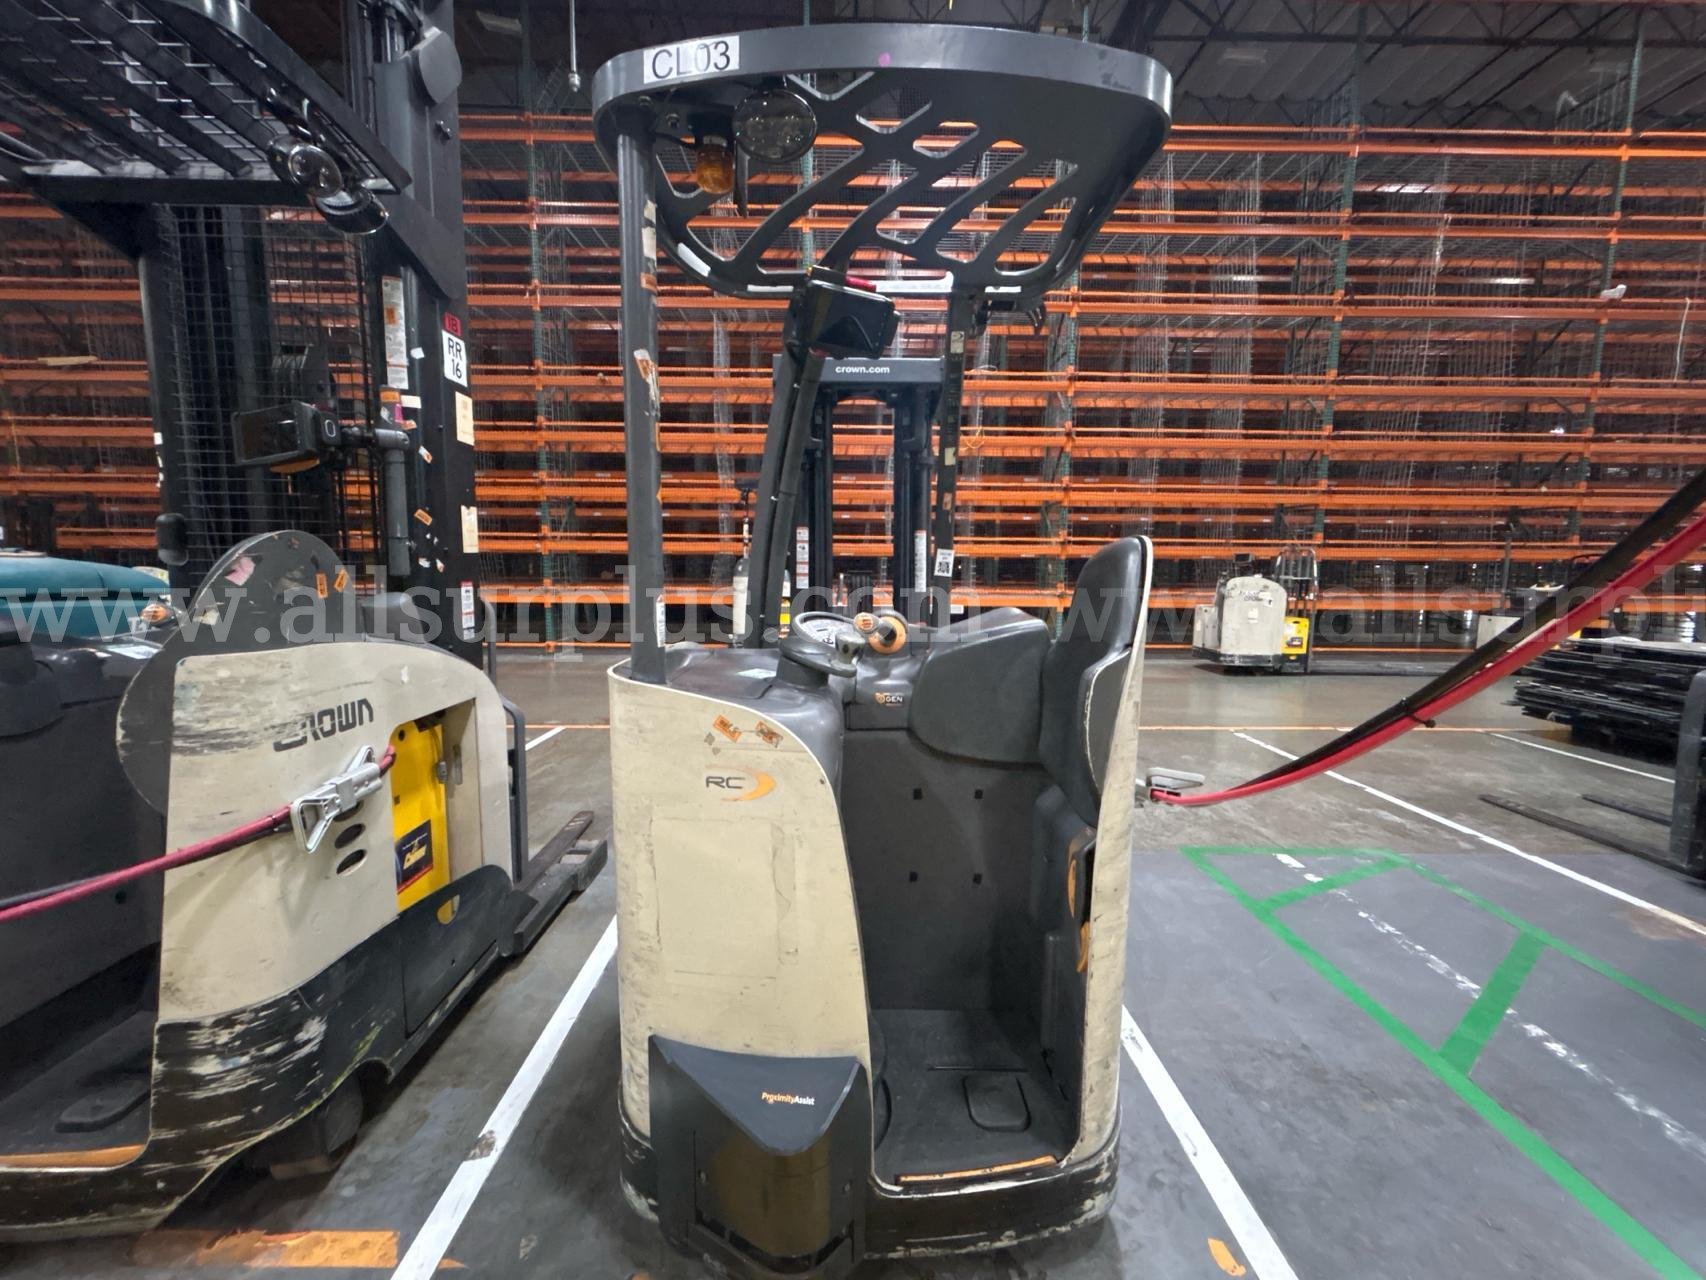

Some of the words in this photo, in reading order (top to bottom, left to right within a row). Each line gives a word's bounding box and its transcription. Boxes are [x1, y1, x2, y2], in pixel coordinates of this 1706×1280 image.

[652, 41, 731, 79] CL03
[448, 337, 462, 360] RR
[452, 359, 462, 379] 16
[835, 366, 890, 374] crown.com
[705, 775, 746, 789] RC
